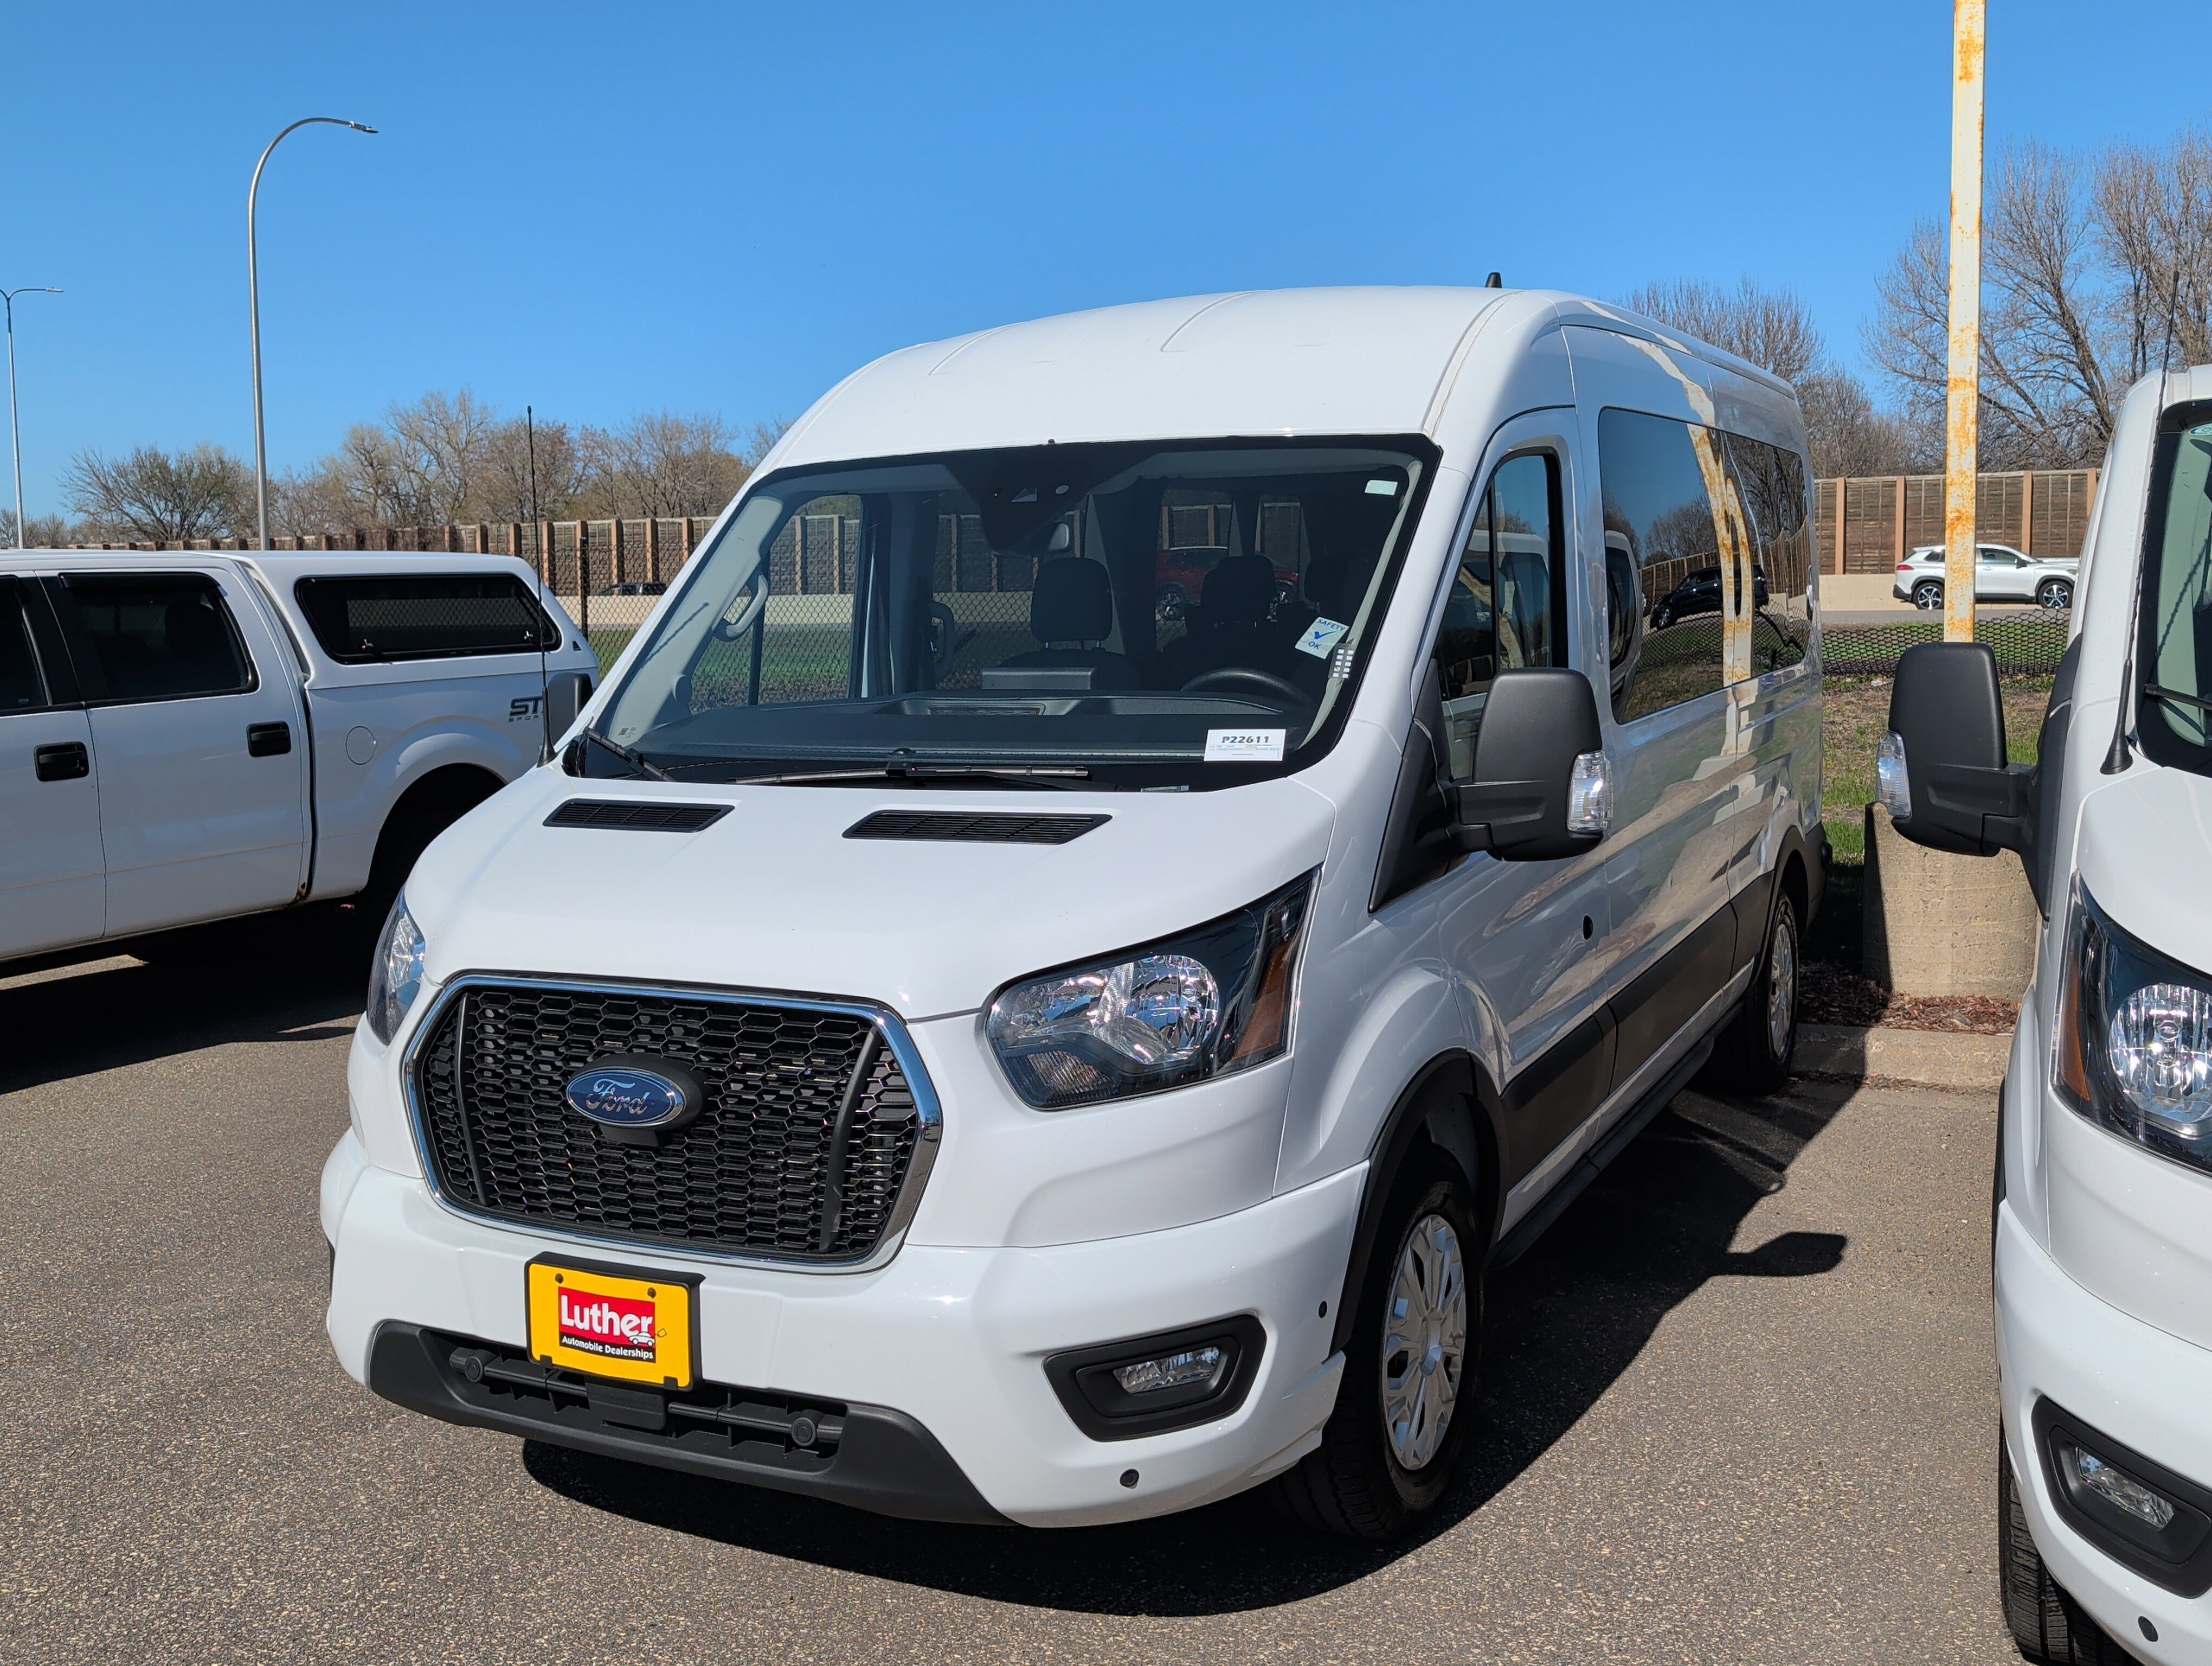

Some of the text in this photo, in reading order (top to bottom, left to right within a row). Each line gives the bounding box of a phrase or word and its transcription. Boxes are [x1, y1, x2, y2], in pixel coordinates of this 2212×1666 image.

[1316, 619, 1346, 631] SAFETY
[1308, 641, 1321, 650] OK
[510, 695, 544, 716] ST
[586, 1079, 651, 1115] Ford
[561, 1295, 653, 1337] Luther
[562, 1335, 653, 1360] Automobile Dealerships
